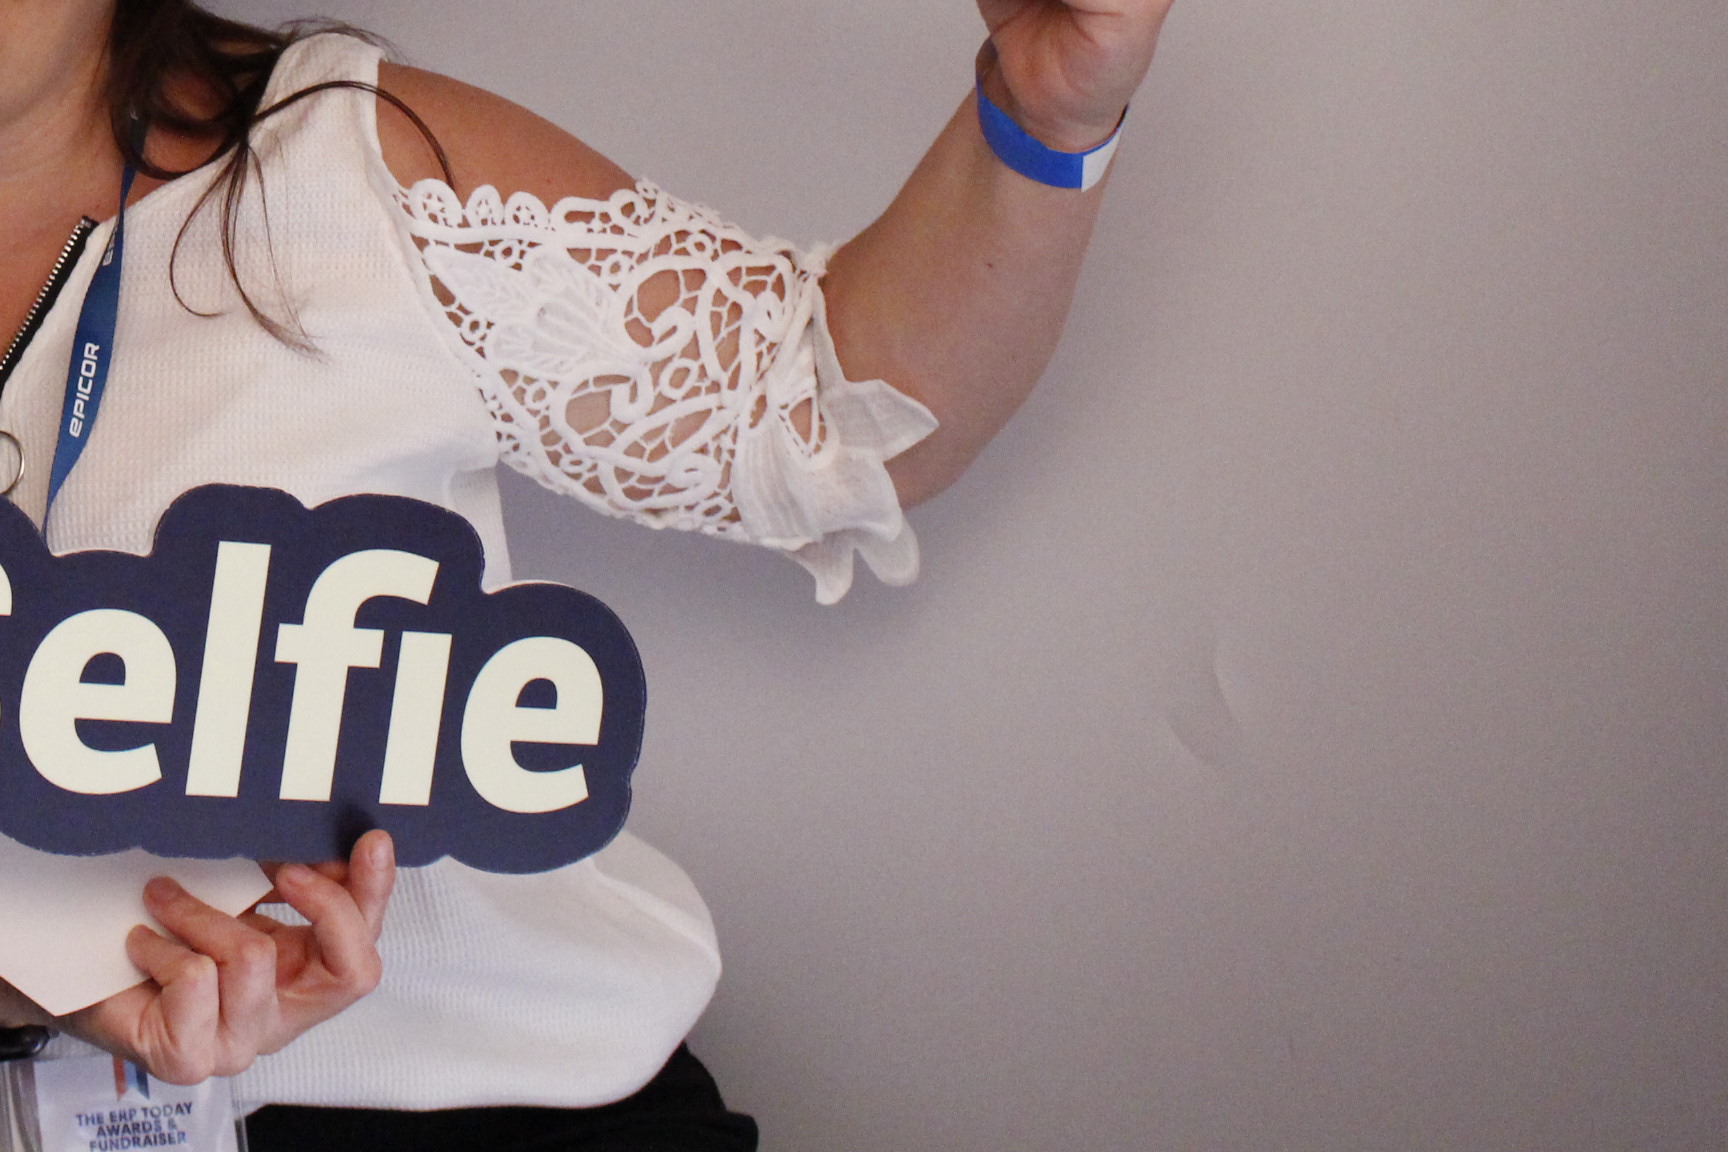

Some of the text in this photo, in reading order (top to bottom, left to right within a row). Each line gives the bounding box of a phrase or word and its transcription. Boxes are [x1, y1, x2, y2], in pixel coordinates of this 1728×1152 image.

[75, 1101, 193, 1127] THE ERP TODAY
[97, 1120, 163, 1138] AWARDS
[89, 1131, 187, 1152] FUNDRAISER
